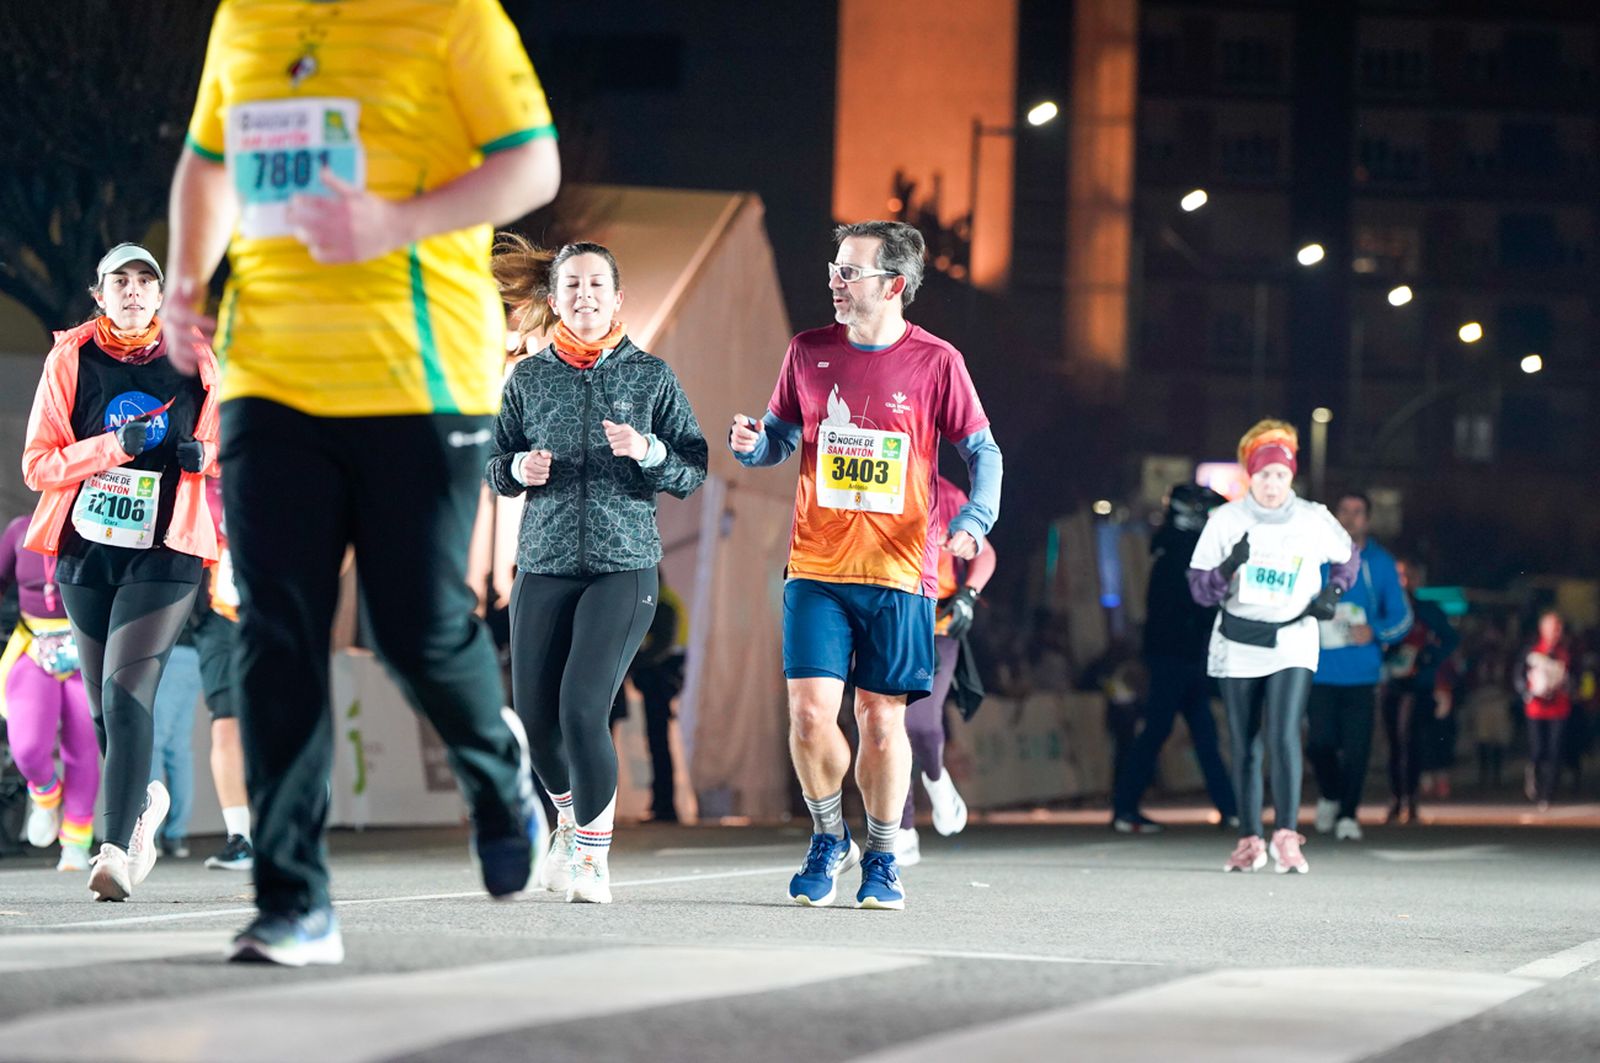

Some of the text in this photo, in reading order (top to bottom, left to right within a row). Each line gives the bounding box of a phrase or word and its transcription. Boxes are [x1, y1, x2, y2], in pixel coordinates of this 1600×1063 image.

[837, 437, 863, 446] NOCHE
[864, 439, 874, 447] DE
[827, 445, 844, 455] SAN
[831, 456, 889, 484] 3403
[120, 477, 132, 486] DE
[87, 492, 145, 522] 12108
[1255, 567, 1293, 588] 8841
